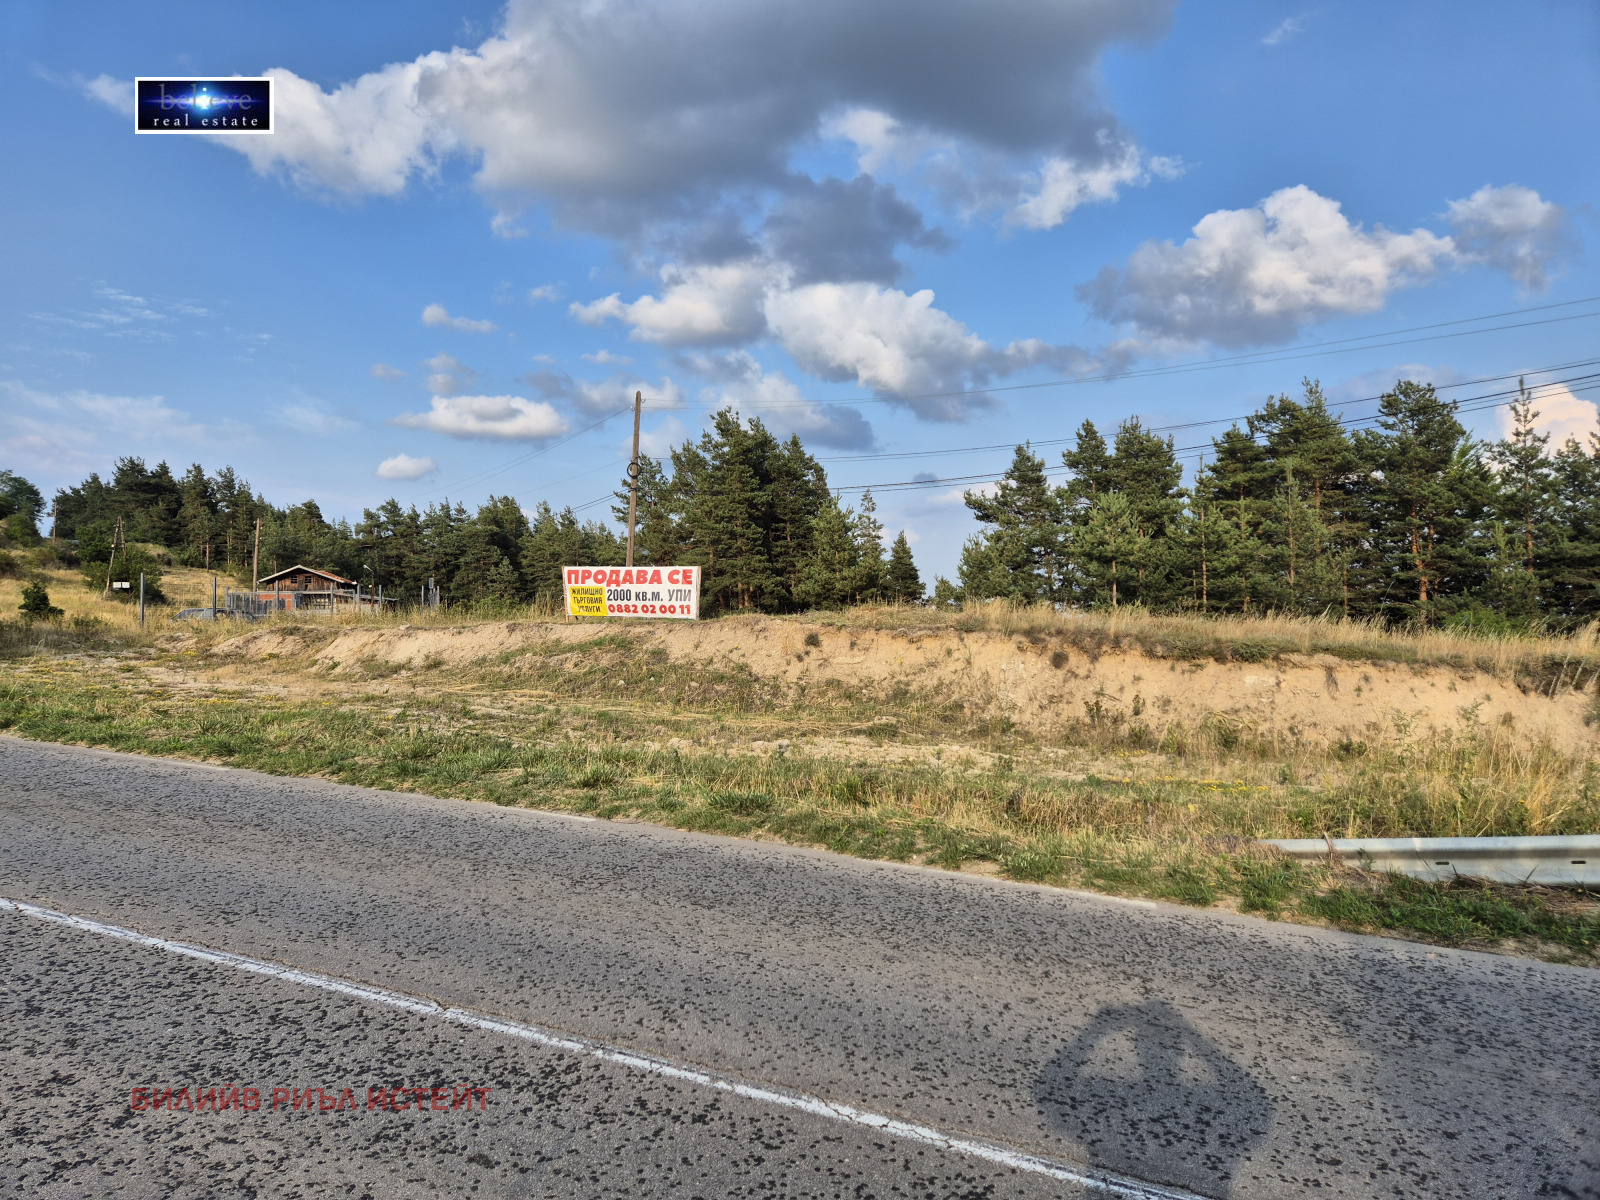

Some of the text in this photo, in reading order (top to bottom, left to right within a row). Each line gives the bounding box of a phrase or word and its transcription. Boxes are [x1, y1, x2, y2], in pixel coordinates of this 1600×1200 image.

[567, 569, 693, 587] ПРОДАВА СЕ
[606, 589, 631, 601] 2000
[667, 589, 691, 602] УПИ
[607, 604, 691, 614] 0882 02 00 11
